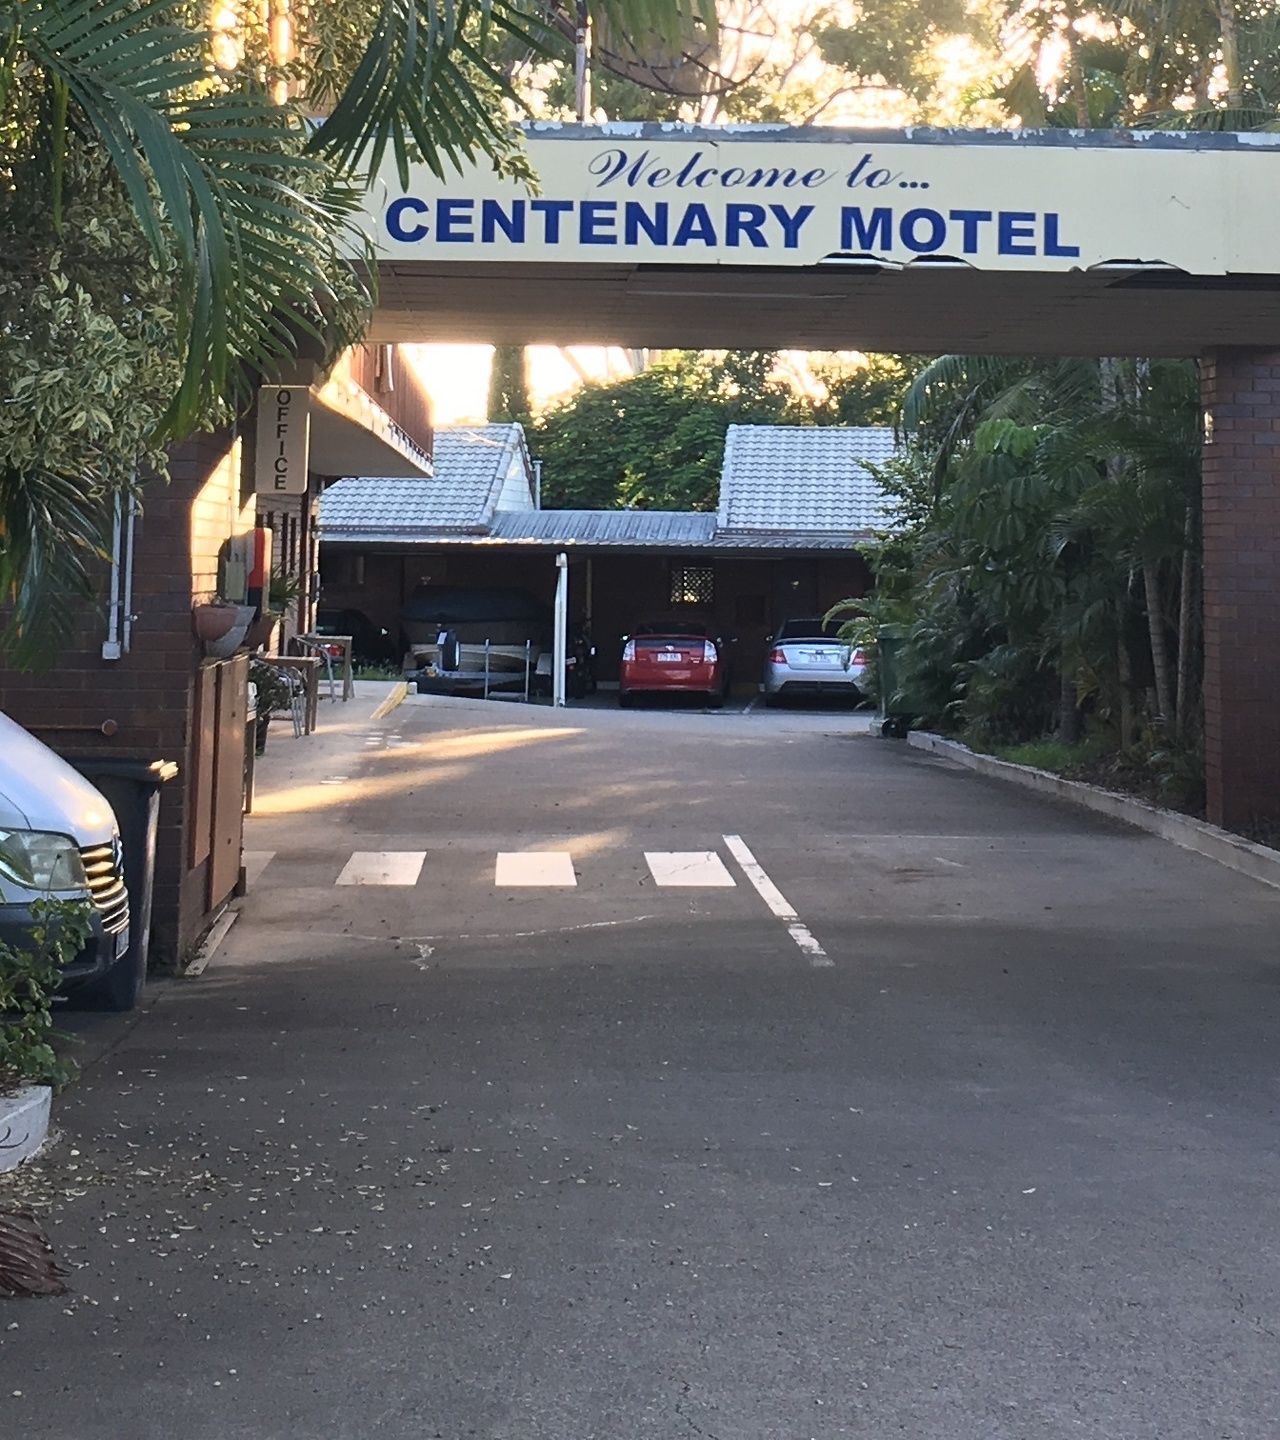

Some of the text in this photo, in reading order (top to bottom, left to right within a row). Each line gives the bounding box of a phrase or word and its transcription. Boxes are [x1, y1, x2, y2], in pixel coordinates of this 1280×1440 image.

[588, 149, 931, 190] Welcome to...
[385, 197, 1081, 258] CENTENARY MOTEL
[274, 389, 292, 491] OFFICE
